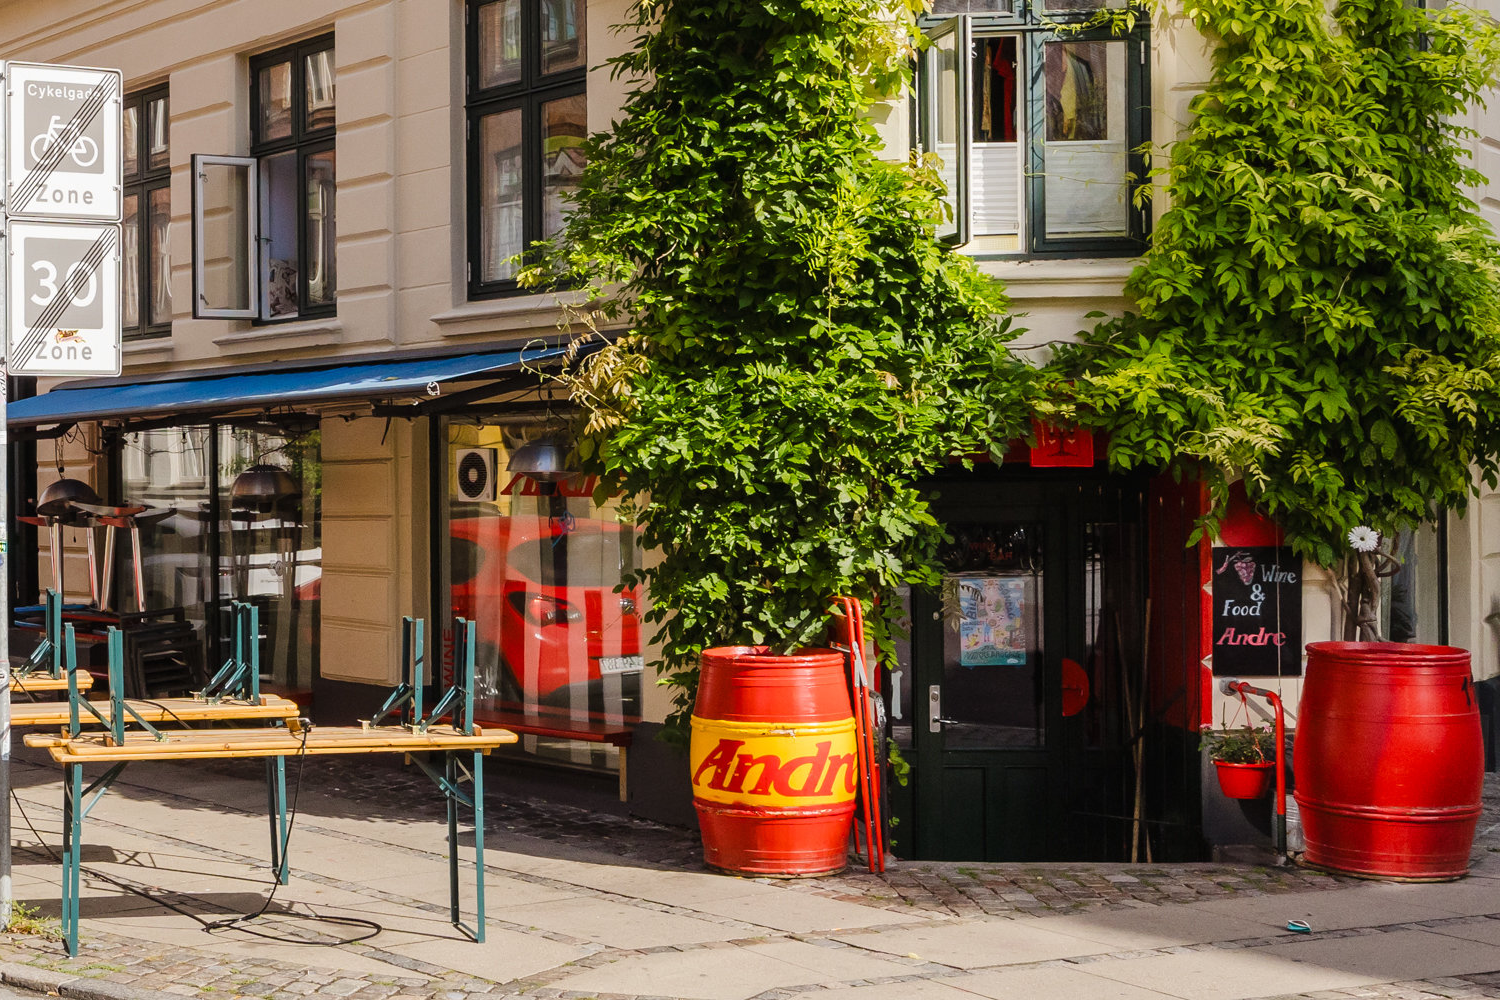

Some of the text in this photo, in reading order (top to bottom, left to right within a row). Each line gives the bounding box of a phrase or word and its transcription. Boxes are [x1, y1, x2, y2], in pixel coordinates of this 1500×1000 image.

[35, 184, 94, 204] Zone
[30, 260, 98, 308] 30
[35, 340, 93, 360] Zone
[1261, 564, 1297, 583] Wine
[1250, 583, 1266, 601] &
[1221, 600, 1263, 616] Food
[1216, 627, 1287, 647] Andre
[443, 629, 455, 688] WINE
